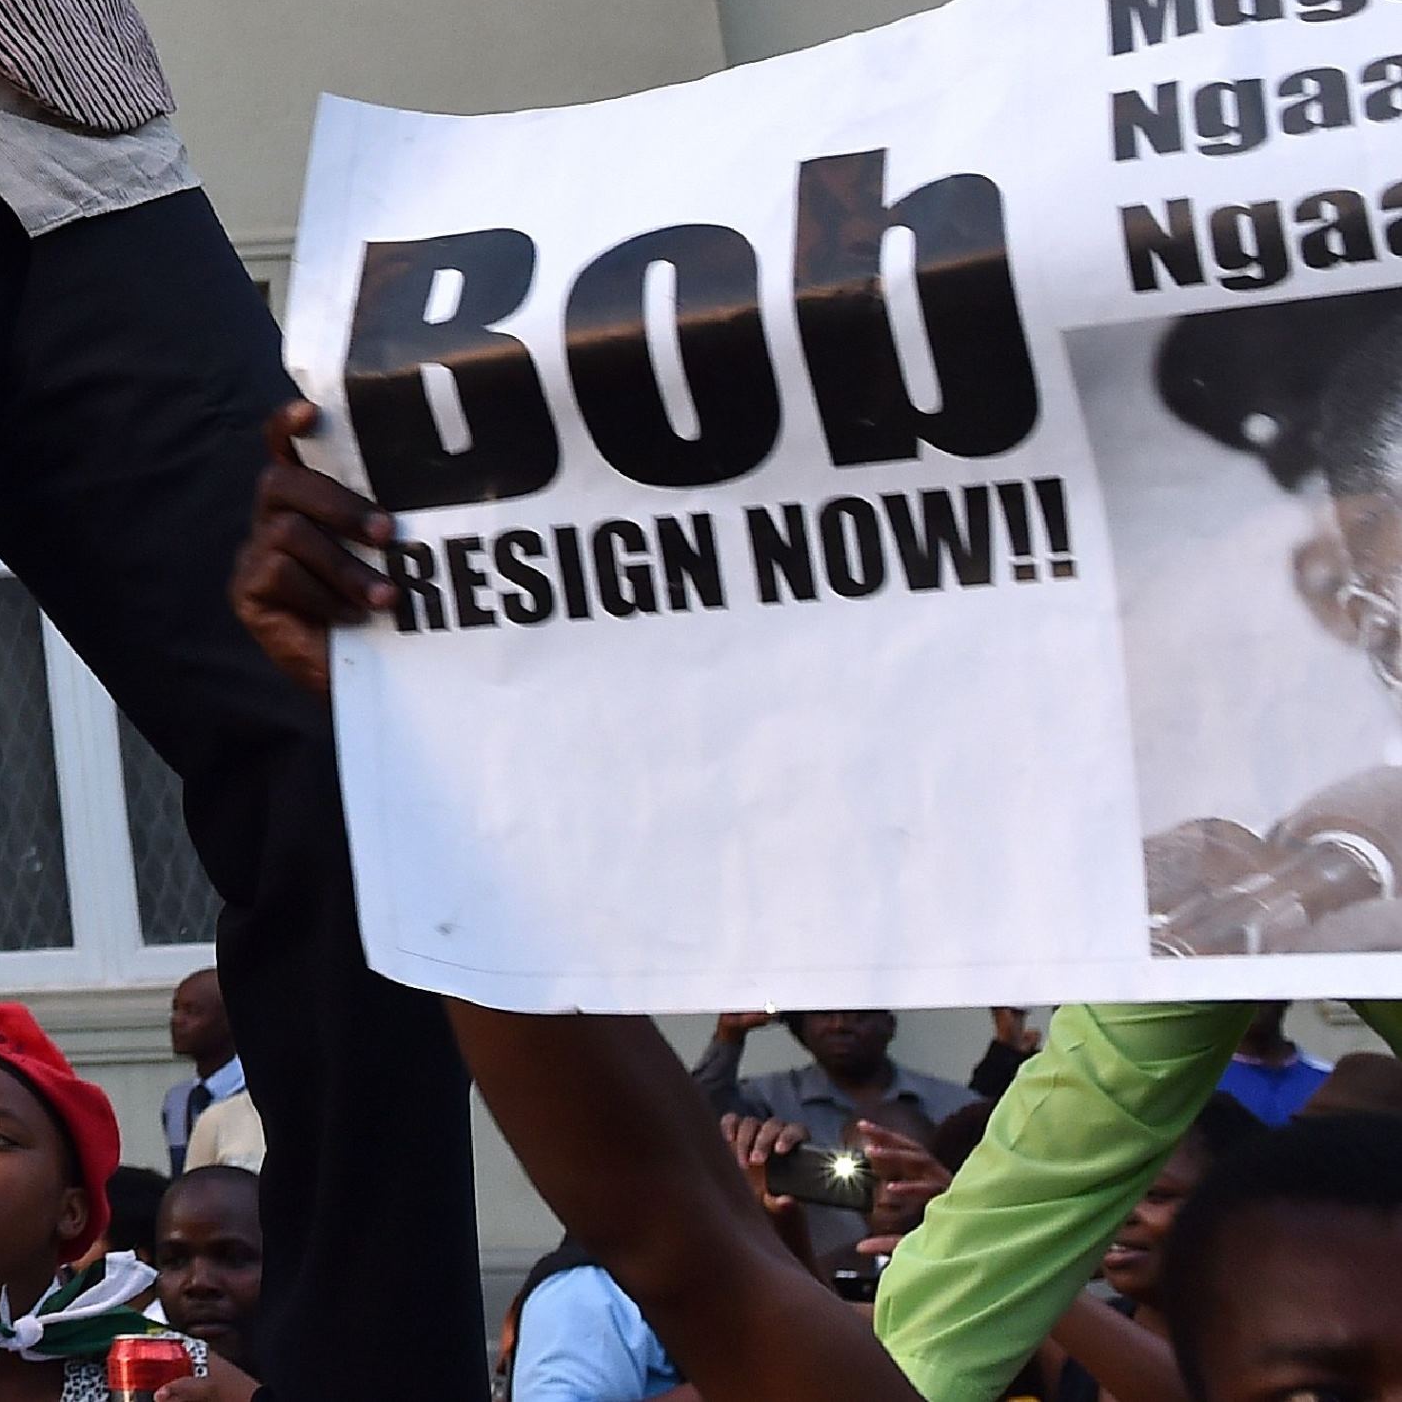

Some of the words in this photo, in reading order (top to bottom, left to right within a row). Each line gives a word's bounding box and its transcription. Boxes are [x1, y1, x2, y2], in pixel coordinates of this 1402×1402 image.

[1120, 183, 1402, 293] Nga
[345, 148, 1041, 512] Bob
[386, 510, 728, 634] RESIGN
[744, 477, 1079, 604] NOW!!
